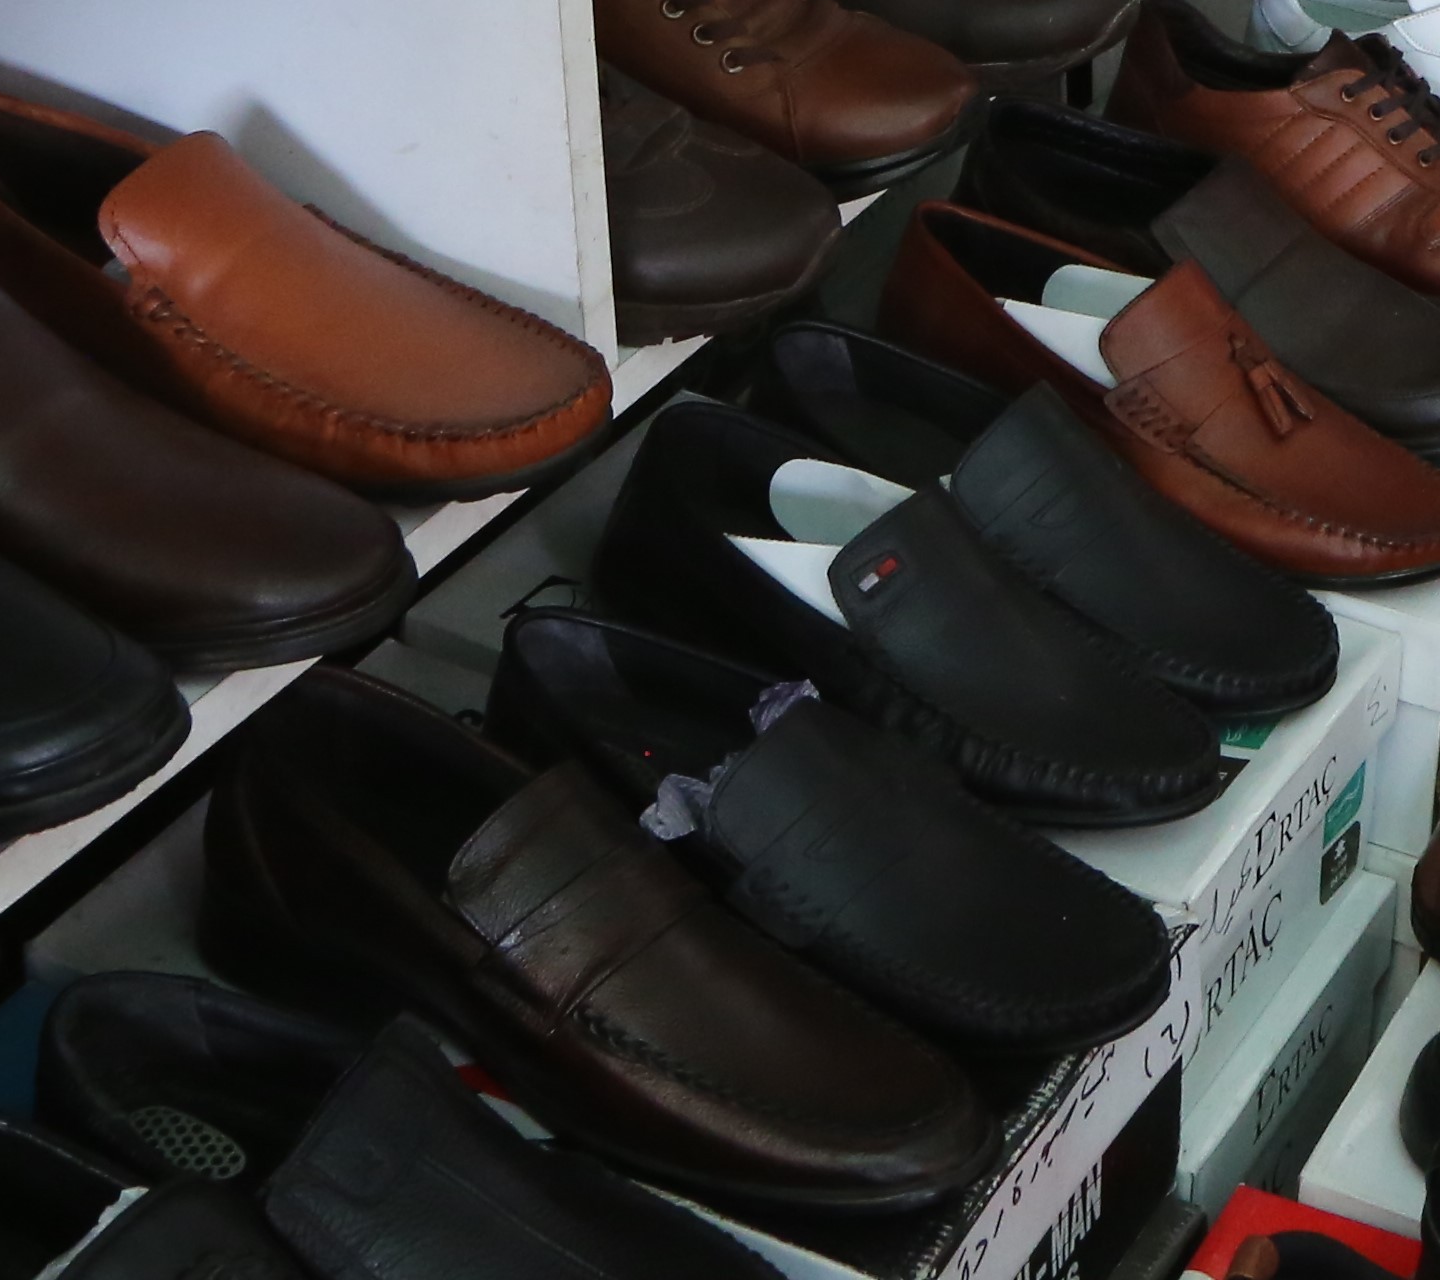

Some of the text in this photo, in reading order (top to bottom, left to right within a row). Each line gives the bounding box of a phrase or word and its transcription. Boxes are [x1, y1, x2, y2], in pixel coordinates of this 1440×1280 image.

[1253, 756, 1337, 889] ERTAÇ
[1183, 892, 1282, 1074] RTAÇ
[1254, 1004, 1333, 1145] ERTAÇ
